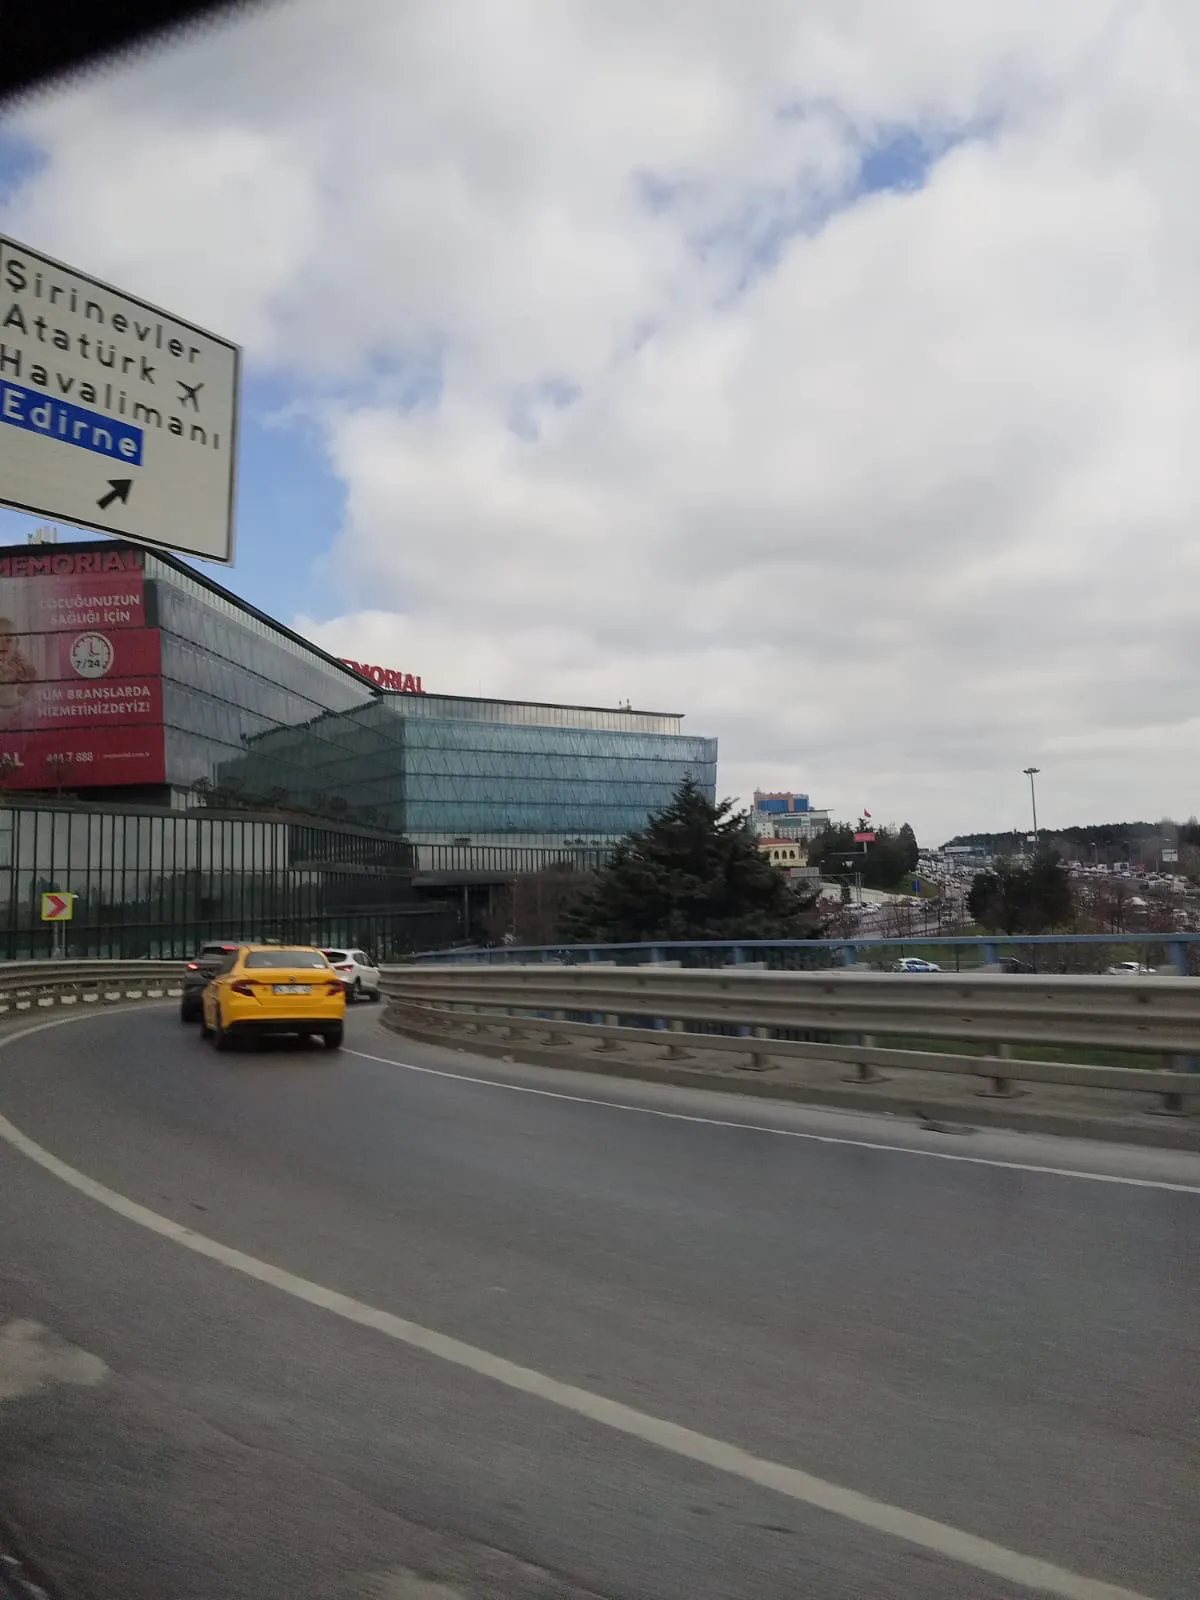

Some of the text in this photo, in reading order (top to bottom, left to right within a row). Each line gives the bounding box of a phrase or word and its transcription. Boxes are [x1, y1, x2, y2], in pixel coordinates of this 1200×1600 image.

[2, 303, 156, 385] Atatürk
[5, 258, 202, 364] Şirinevler
[0, 343, 220, 450] Havalimanı
[3, 388, 139, 457] Edirne
[104, 608, 130, 624] İÇİN
[67, 686, 151, 701] BRANŞLARDA
[76, 659, 100, 669] 7/24
